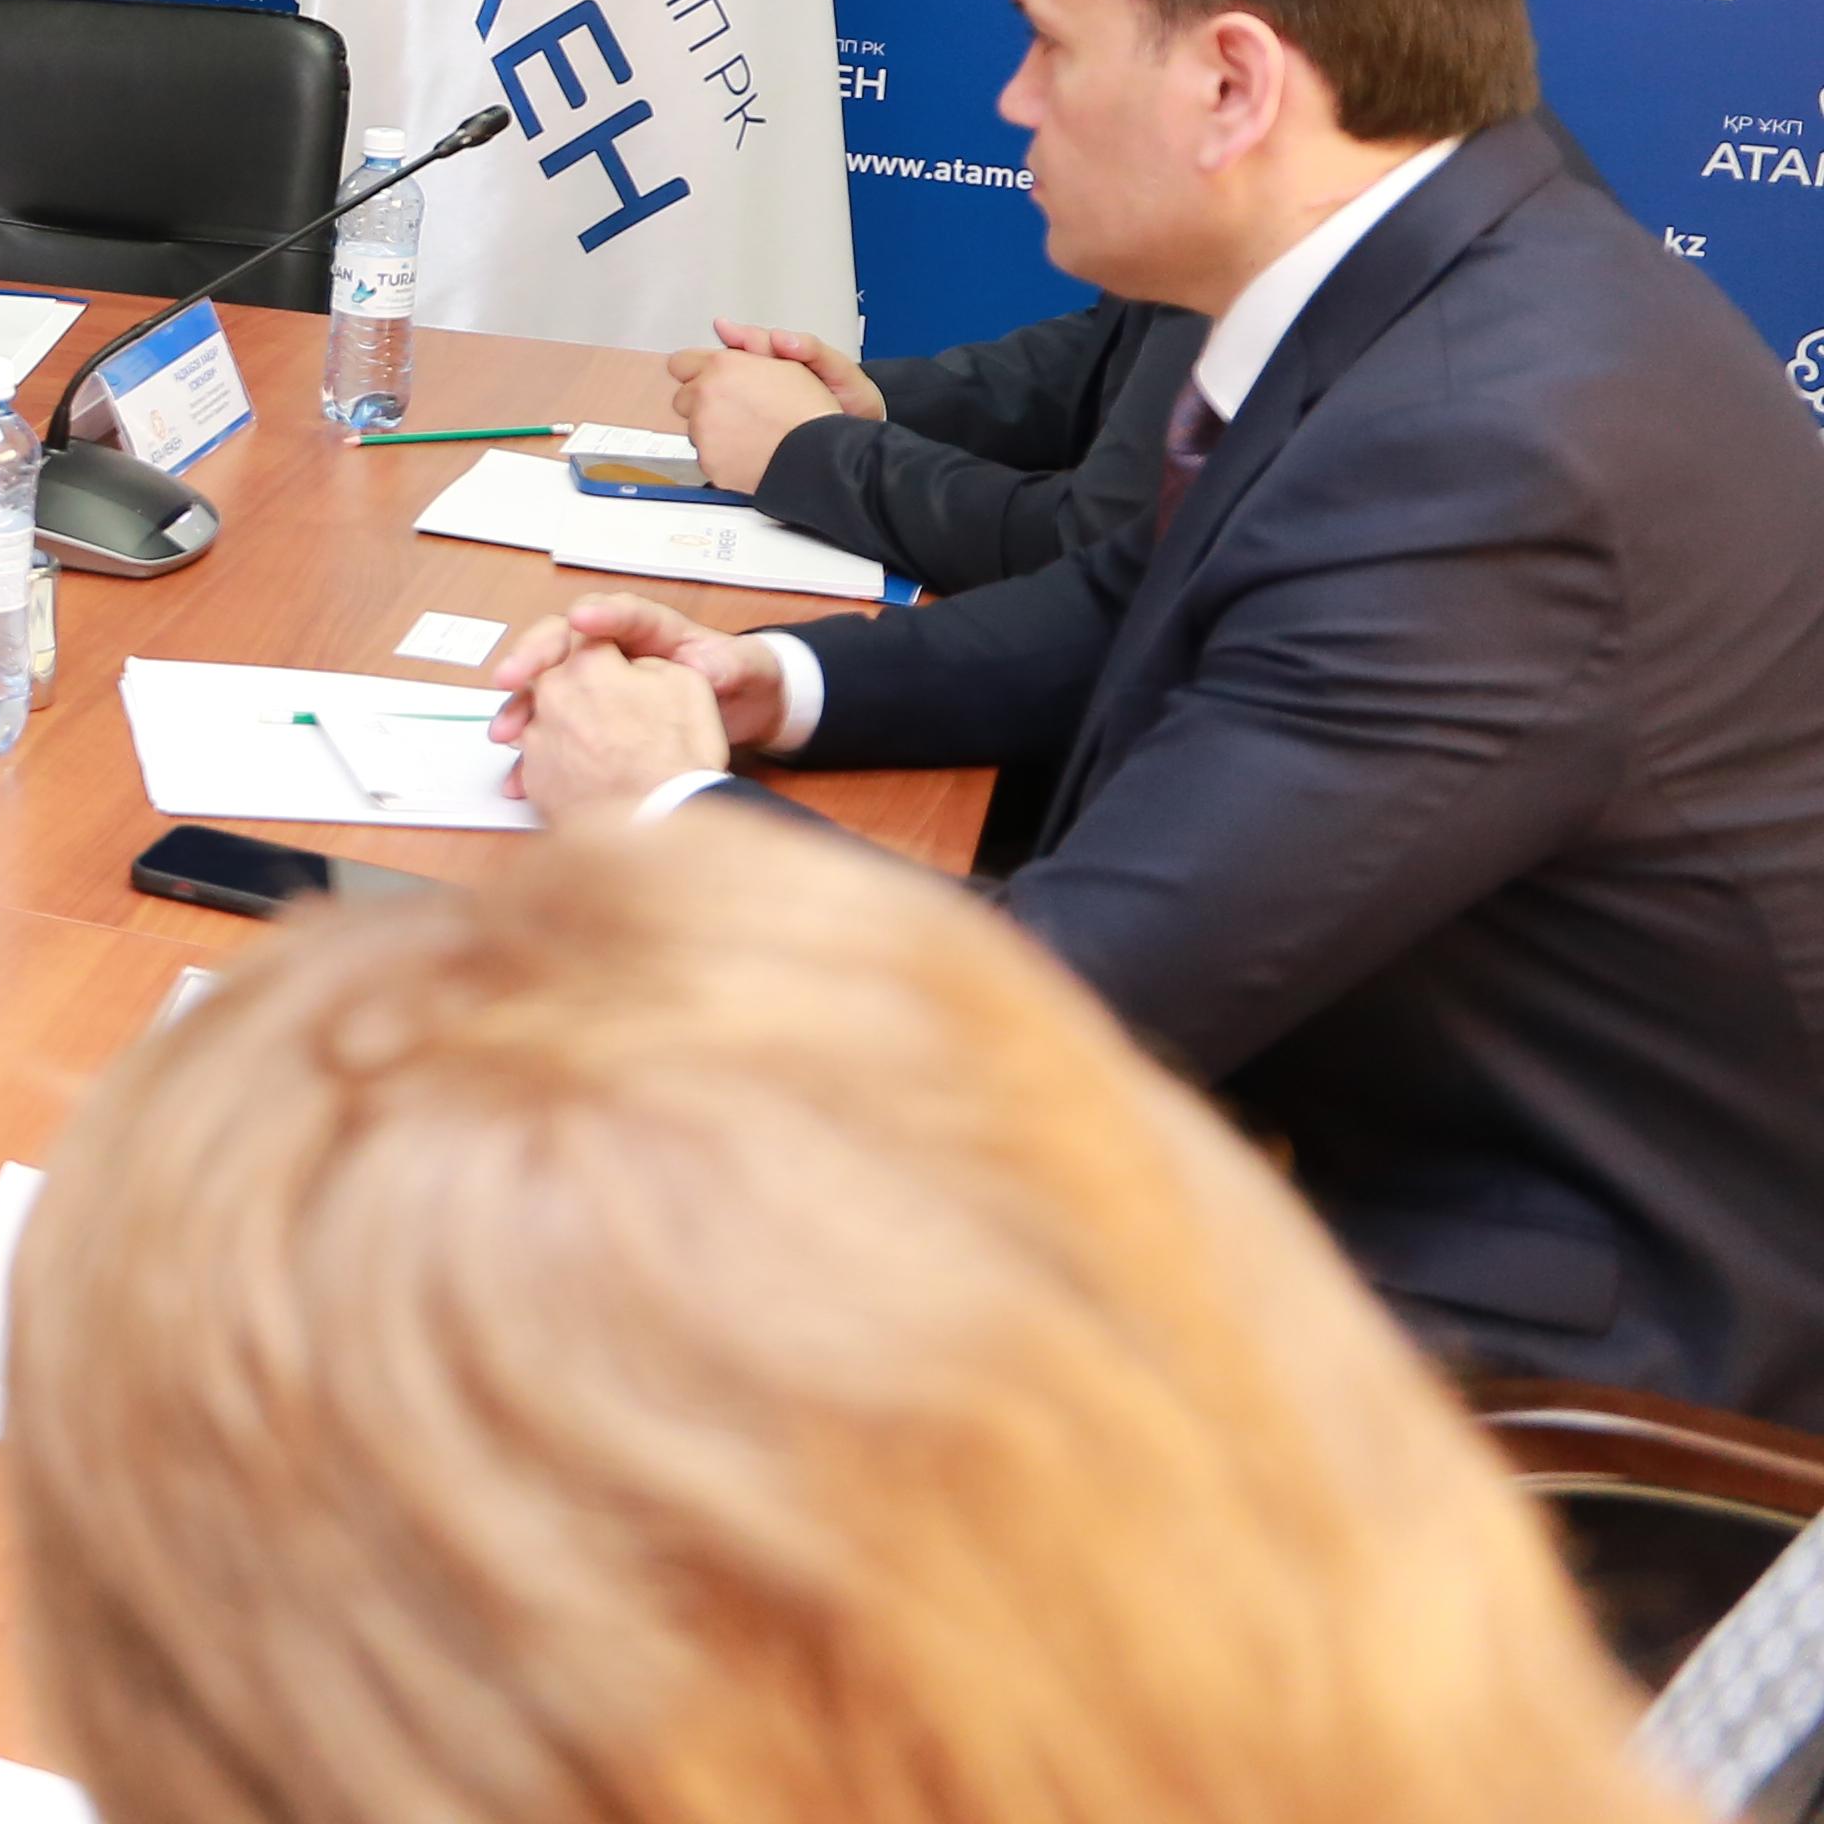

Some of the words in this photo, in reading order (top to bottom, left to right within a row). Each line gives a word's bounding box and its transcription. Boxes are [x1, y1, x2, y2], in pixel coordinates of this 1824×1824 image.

[861, 40, 887, 57] РК
[703, 54, 767, 151] РК
[845, 151, 1036, 191] www.atame
[377, 271, 417, 287] TURA
